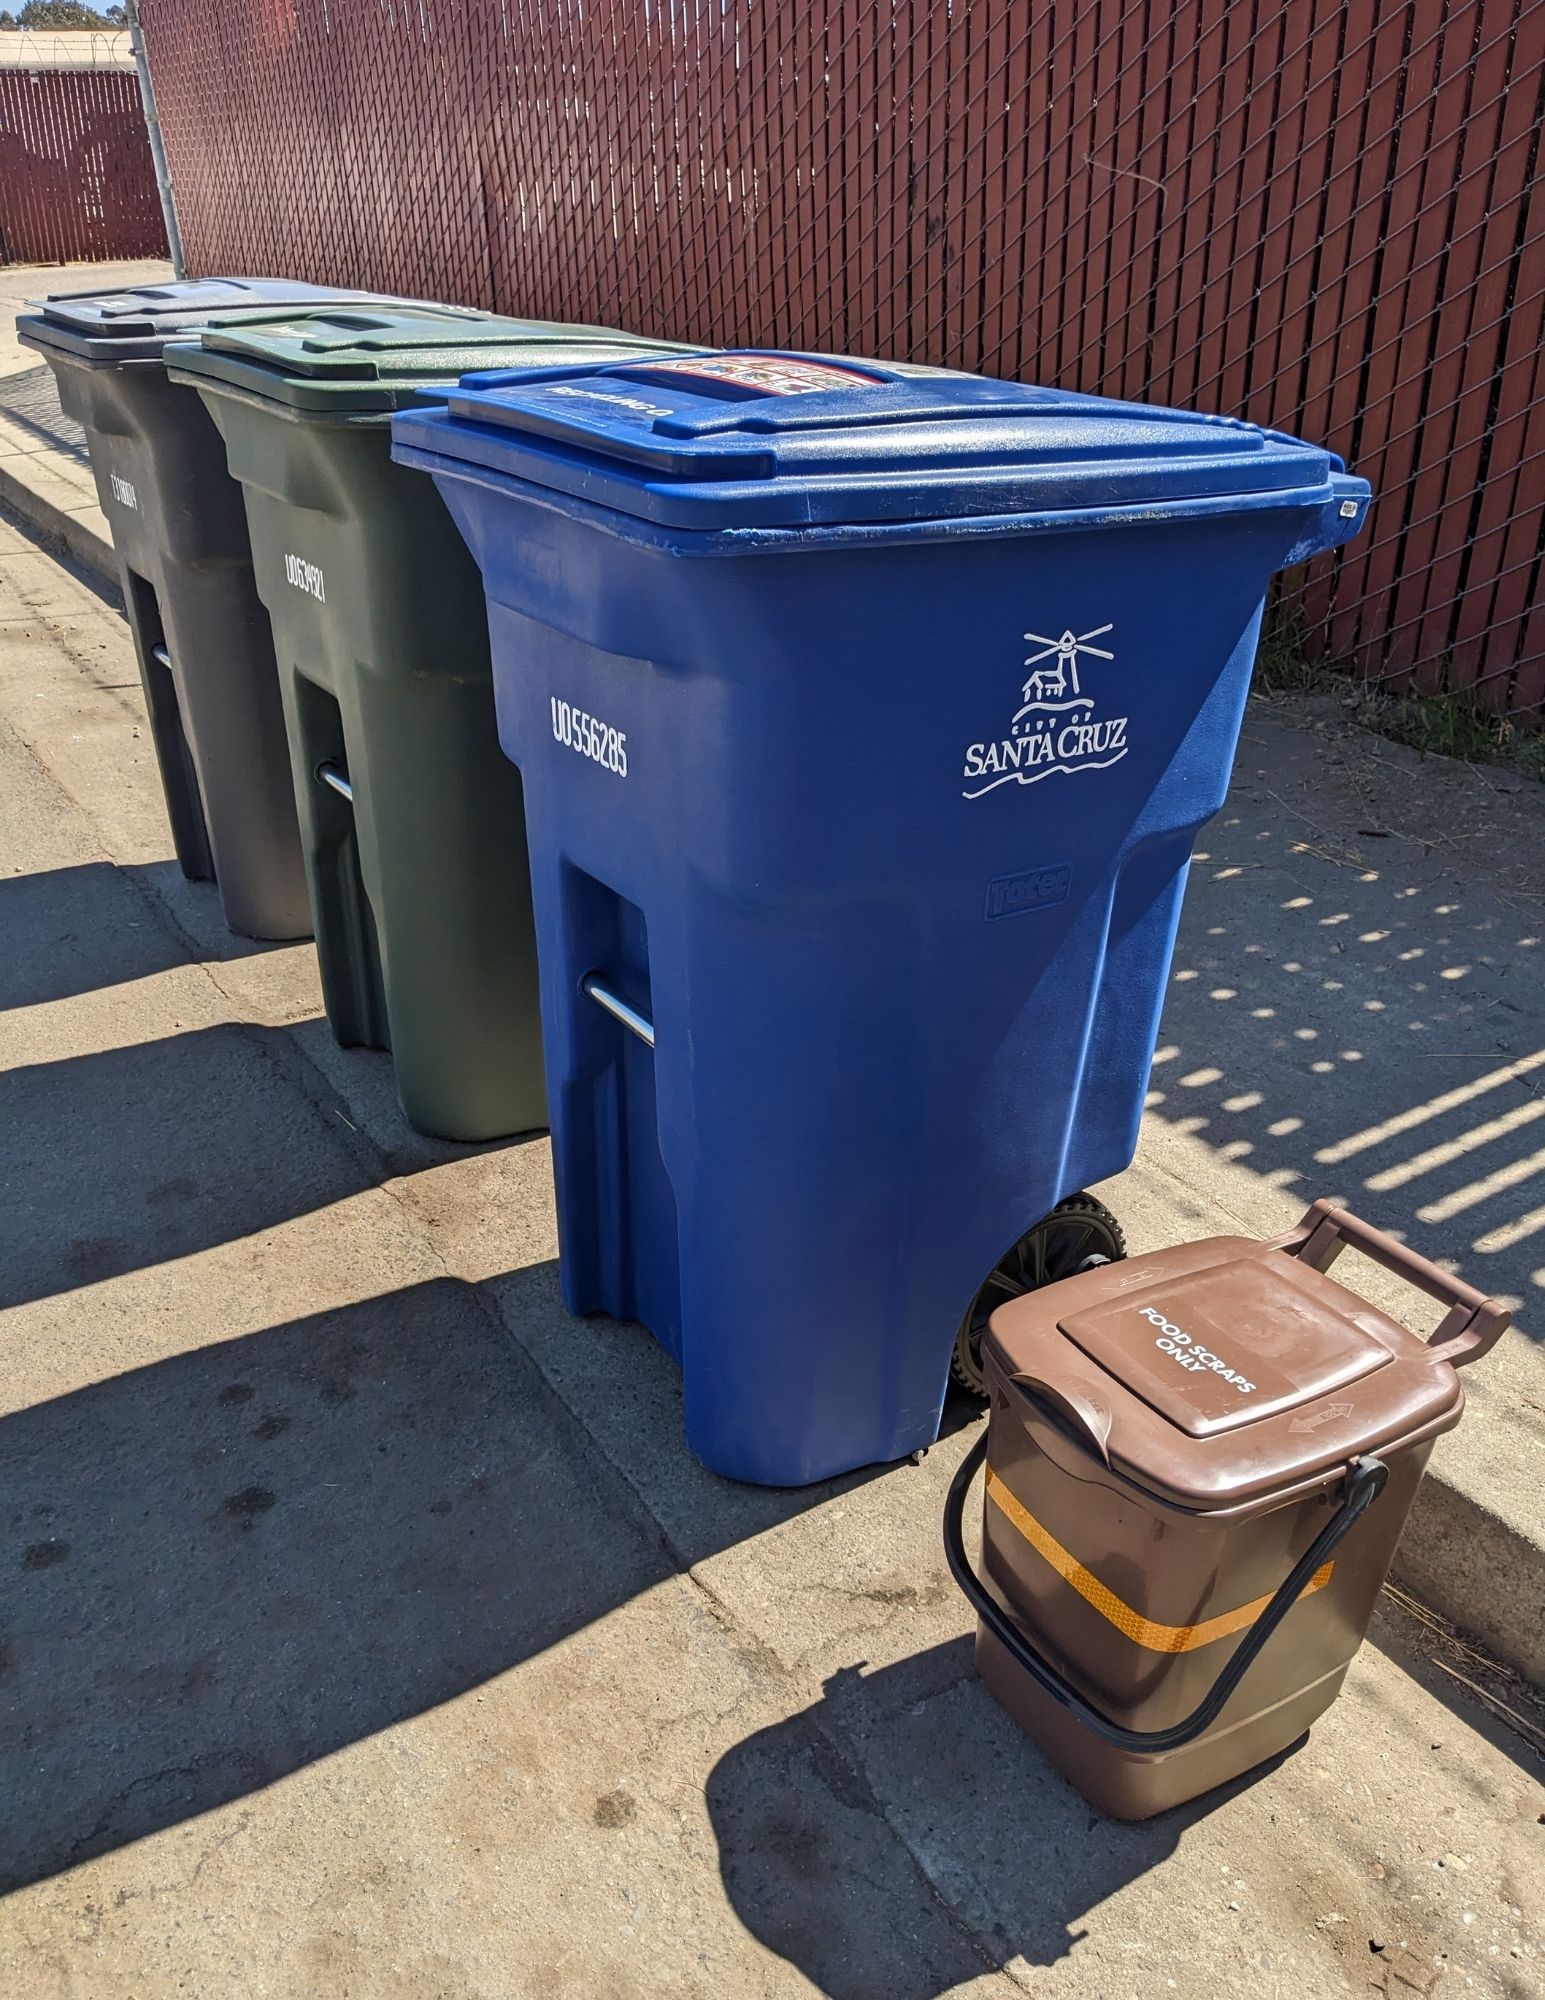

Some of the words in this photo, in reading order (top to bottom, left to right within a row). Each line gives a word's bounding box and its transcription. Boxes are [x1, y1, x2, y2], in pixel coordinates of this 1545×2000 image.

[550, 696, 628, 778] U0556285
[964, 732, 1055, 777] SANTA
[1057, 717, 1128, 758] CRUZ
[1138, 1307, 1192, 1345] FOOD
[1188, 1345, 1256, 1393] SCRAPS
[1156, 1338, 1208, 1373] ONLY
